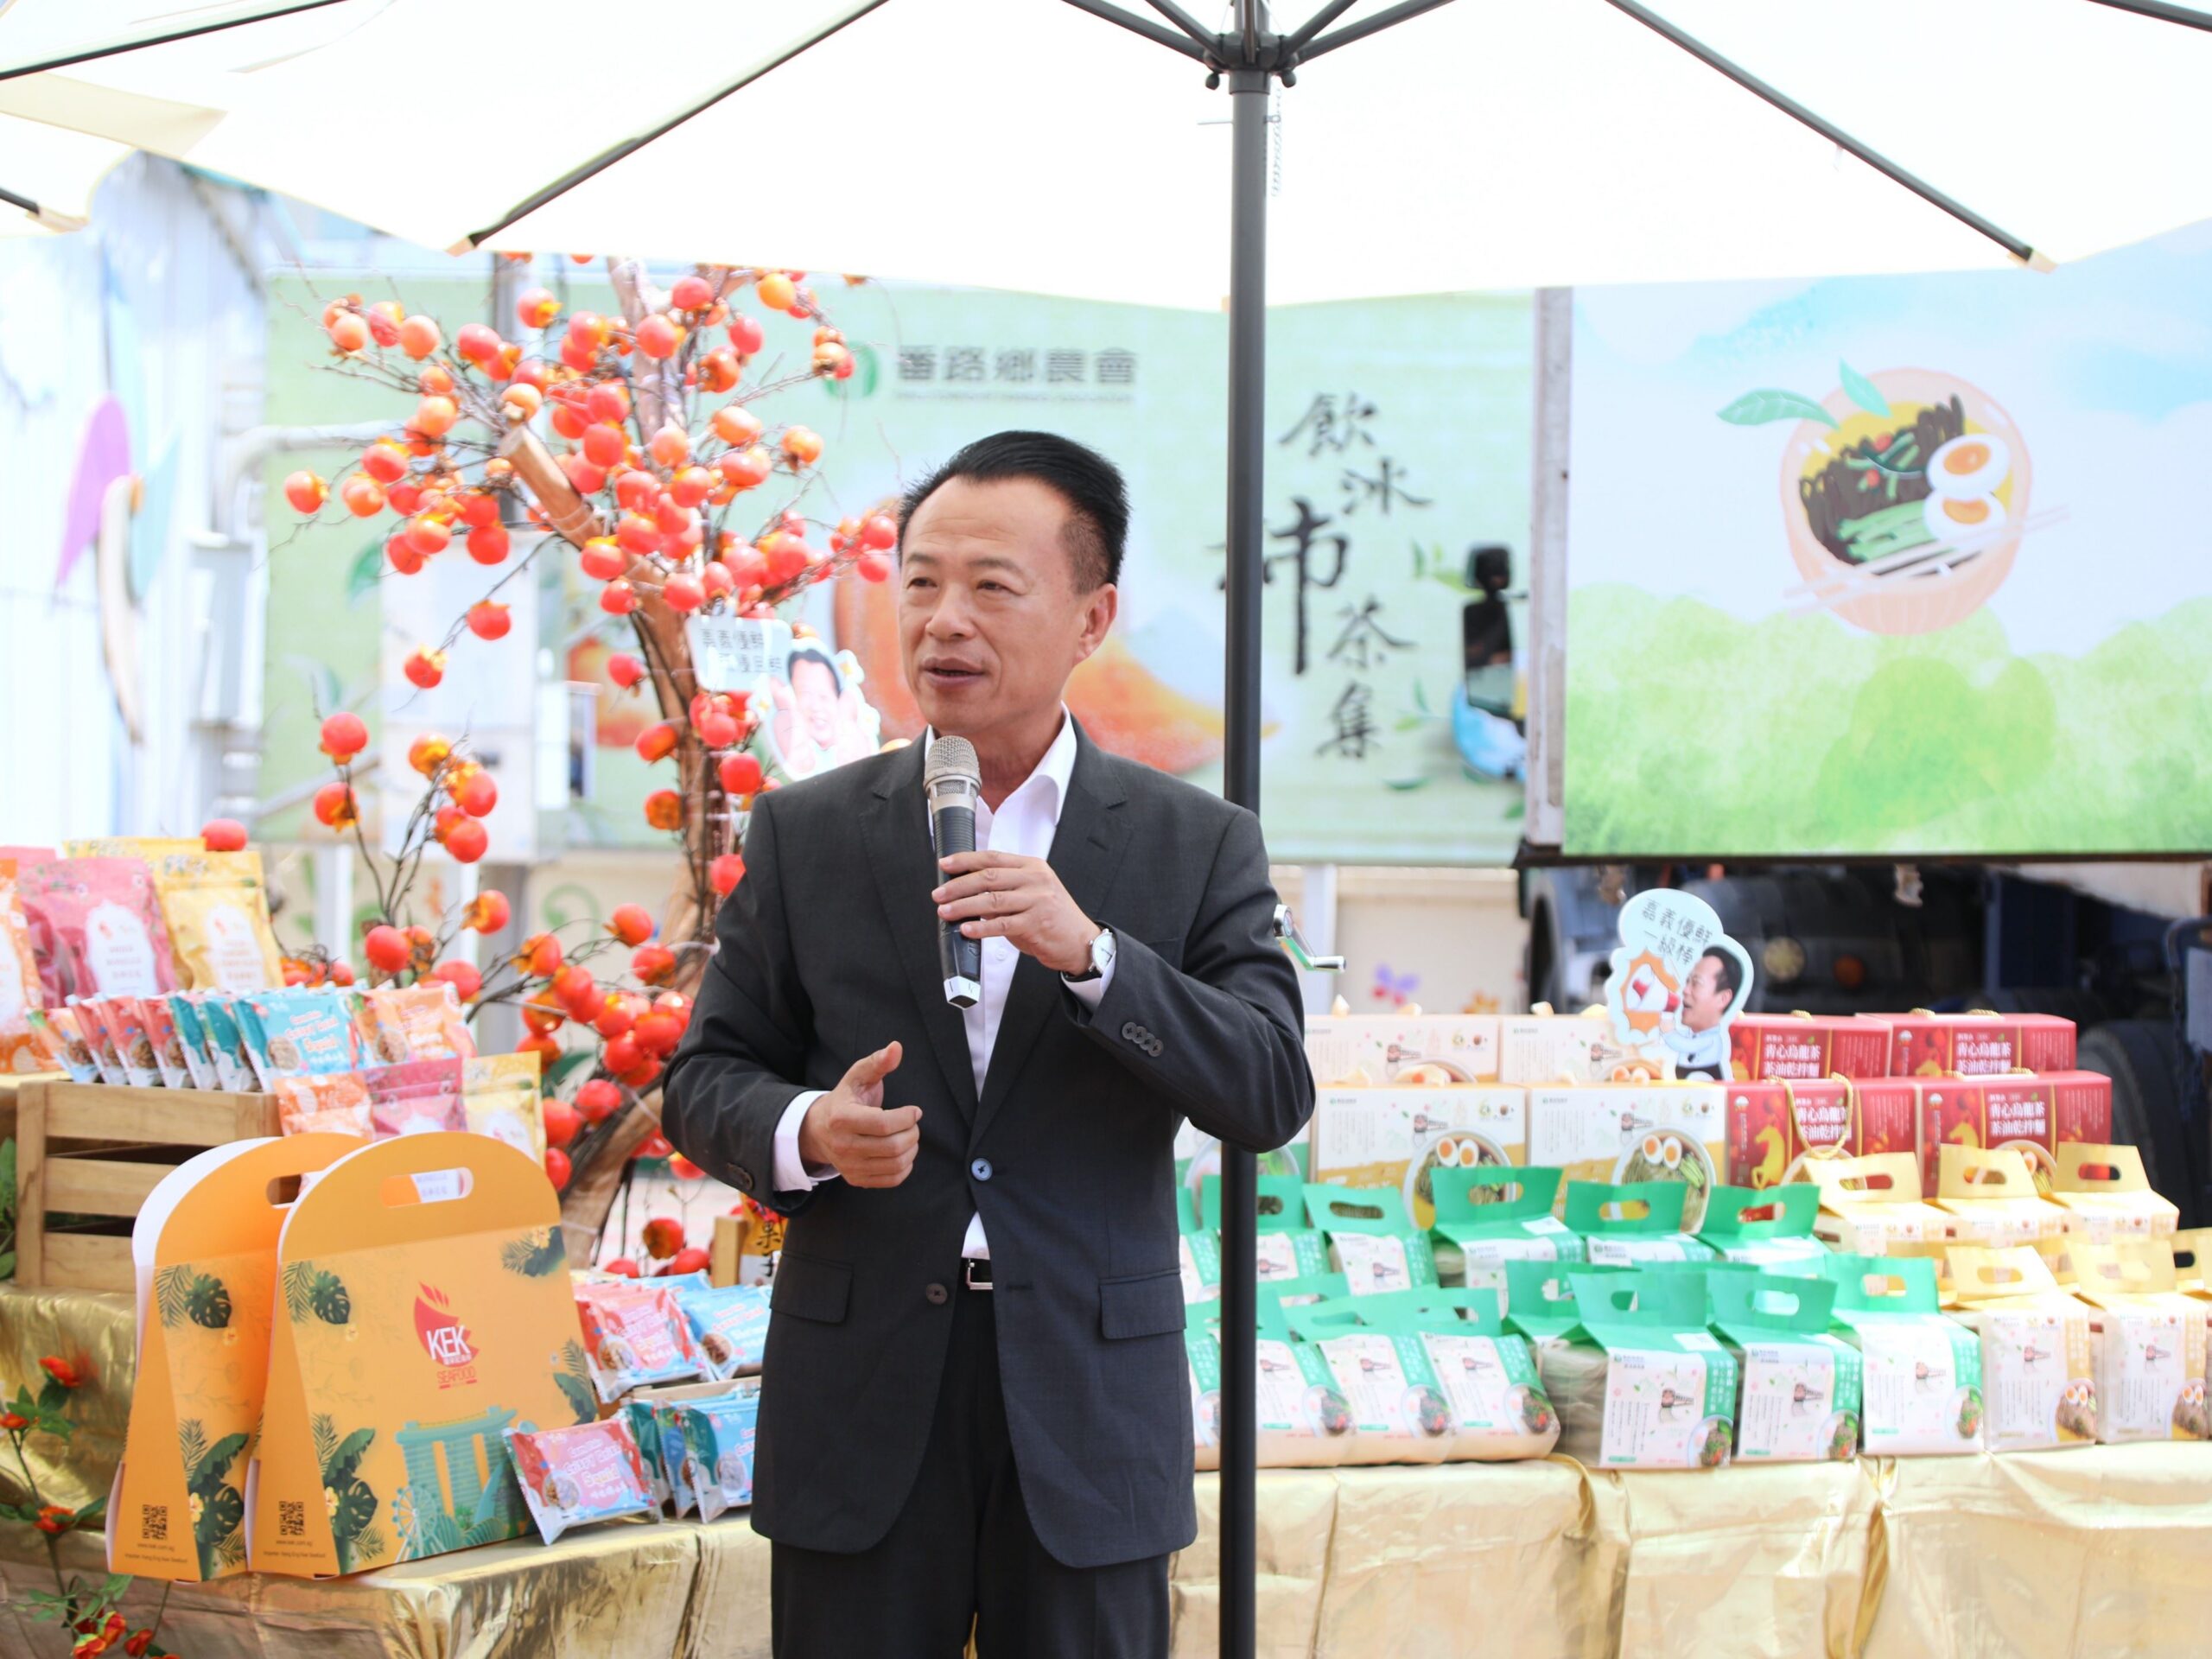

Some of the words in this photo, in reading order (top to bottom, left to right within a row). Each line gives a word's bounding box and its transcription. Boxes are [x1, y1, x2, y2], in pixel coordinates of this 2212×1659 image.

[898, 346, 1137, 383] 番路鄉農會
[1642, 899, 1713, 949] 嘉義優鮮
[426, 1325, 472, 1361] KEK
